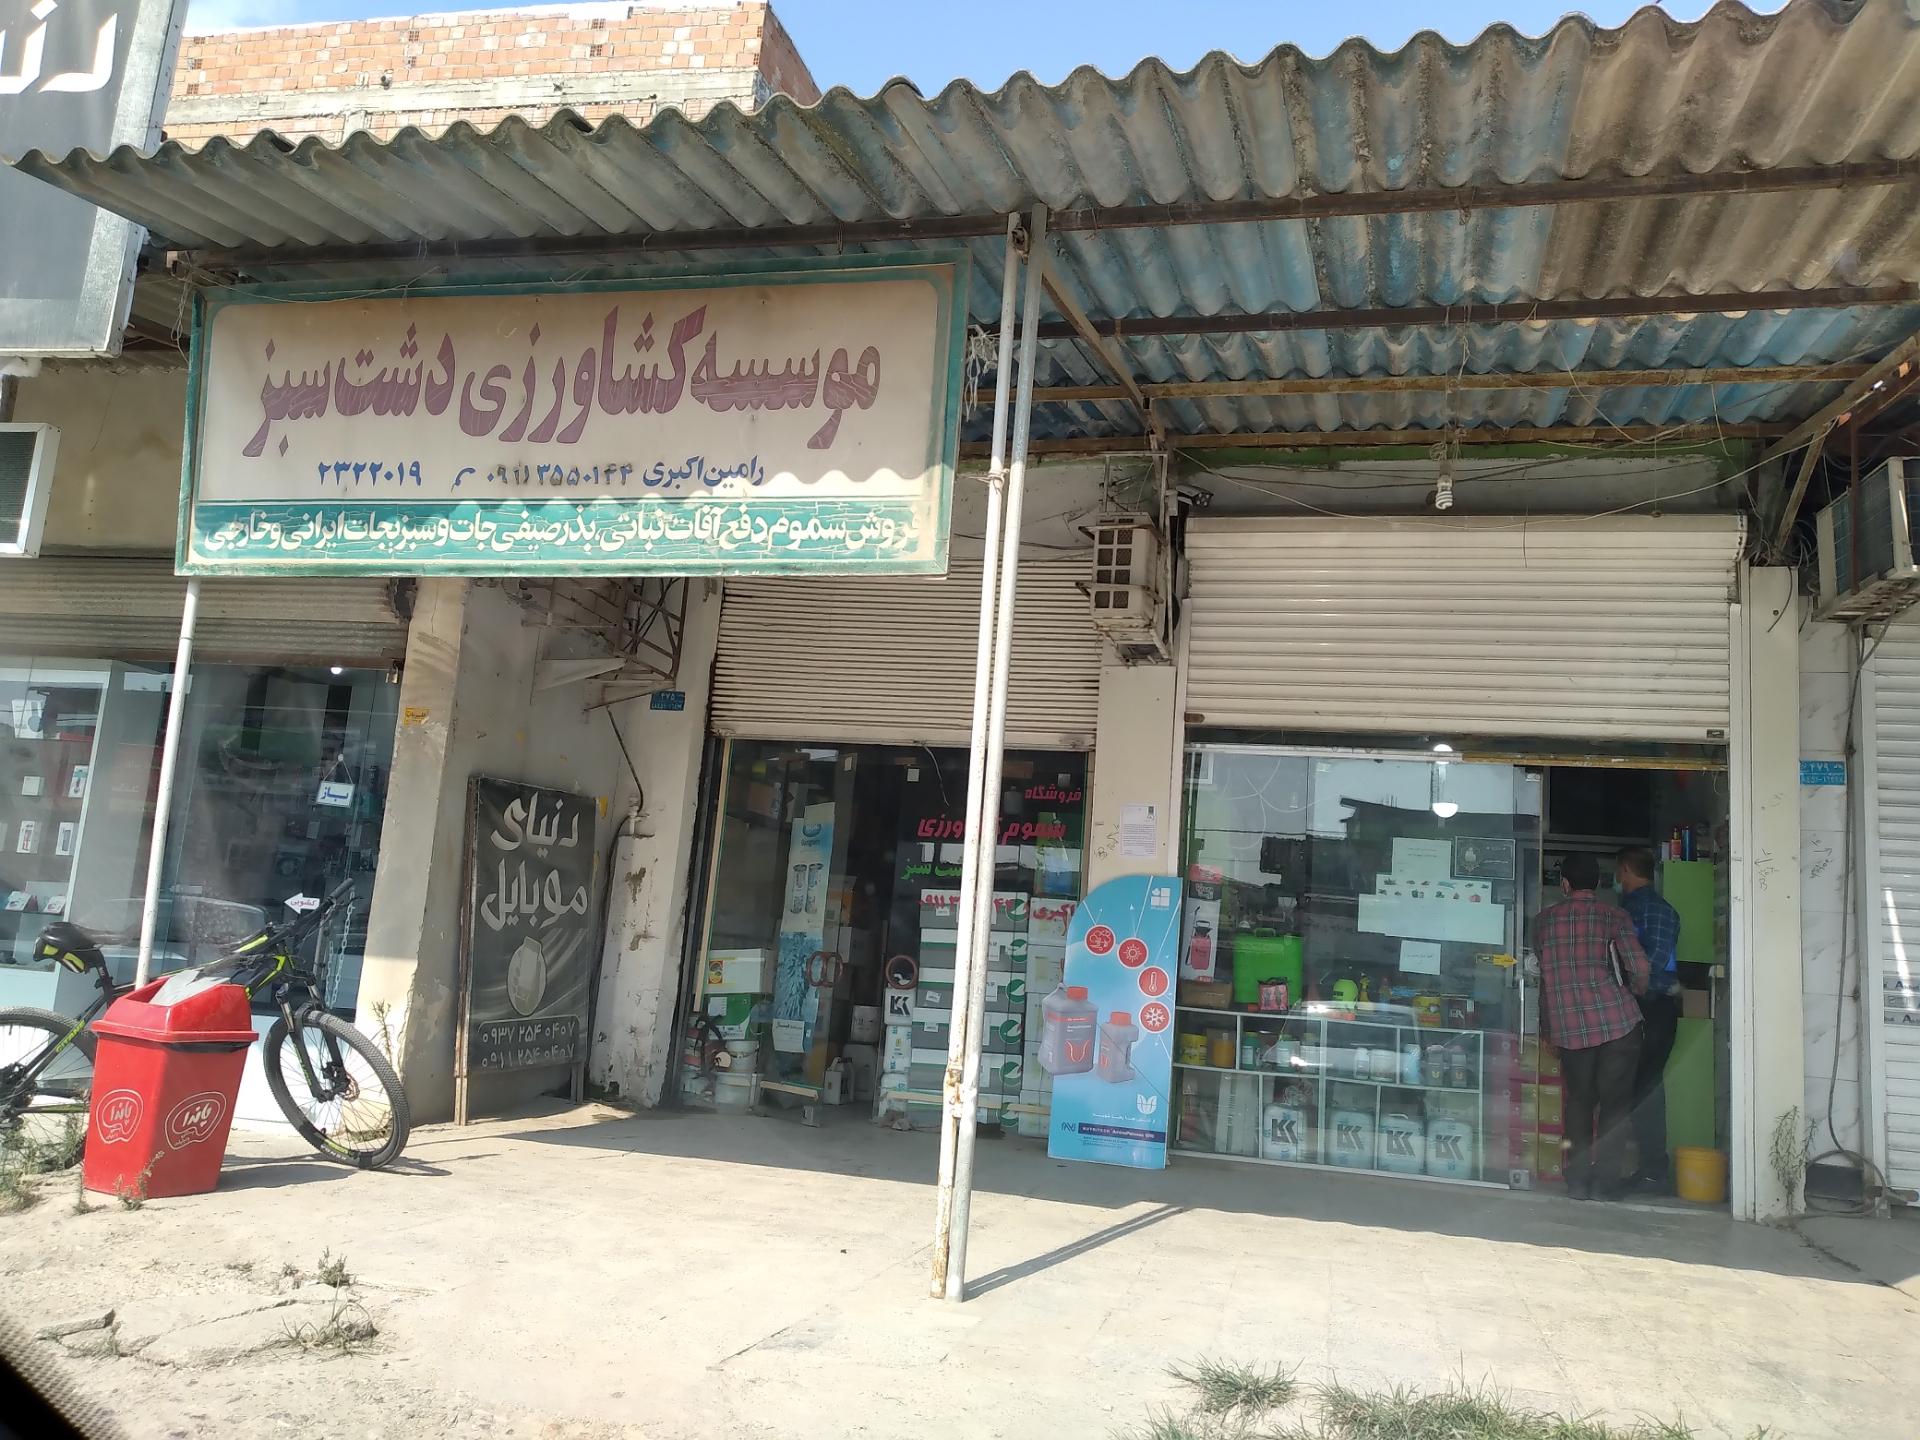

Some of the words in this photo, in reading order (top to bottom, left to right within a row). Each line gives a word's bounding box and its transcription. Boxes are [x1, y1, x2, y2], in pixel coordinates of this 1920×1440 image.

[334, 321, 455, 417] دشت
[459, 304, 707, 443] کشاورزی
[242, 338, 330, 457] سبز
[690, 330, 880, 449] موسسه
[643, 456, 705, 489] اکبری
[703, 455, 764, 488] رامین
[204, 511, 271, 551] خارجی
[280, 510, 345, 551] ایرانی
[553, 505, 597, 553] بذر
[664, 505, 728, 542] آفات
[719, 504, 768, 549] دفع
[768, 517, 846, 551] سموم
[846, 505, 920, 550] فروش
[320, 786, 349, 802] باز
[1024, 784, 1082, 803] فروشگاه
[490, 791, 580, 859] دنیای
[1001, 821, 1067, 846] سموم
[480, 859, 588, 932] موبایل
[110, 1101, 132, 1125] پاندا
[182, 1103, 212, 1127] پاندا
